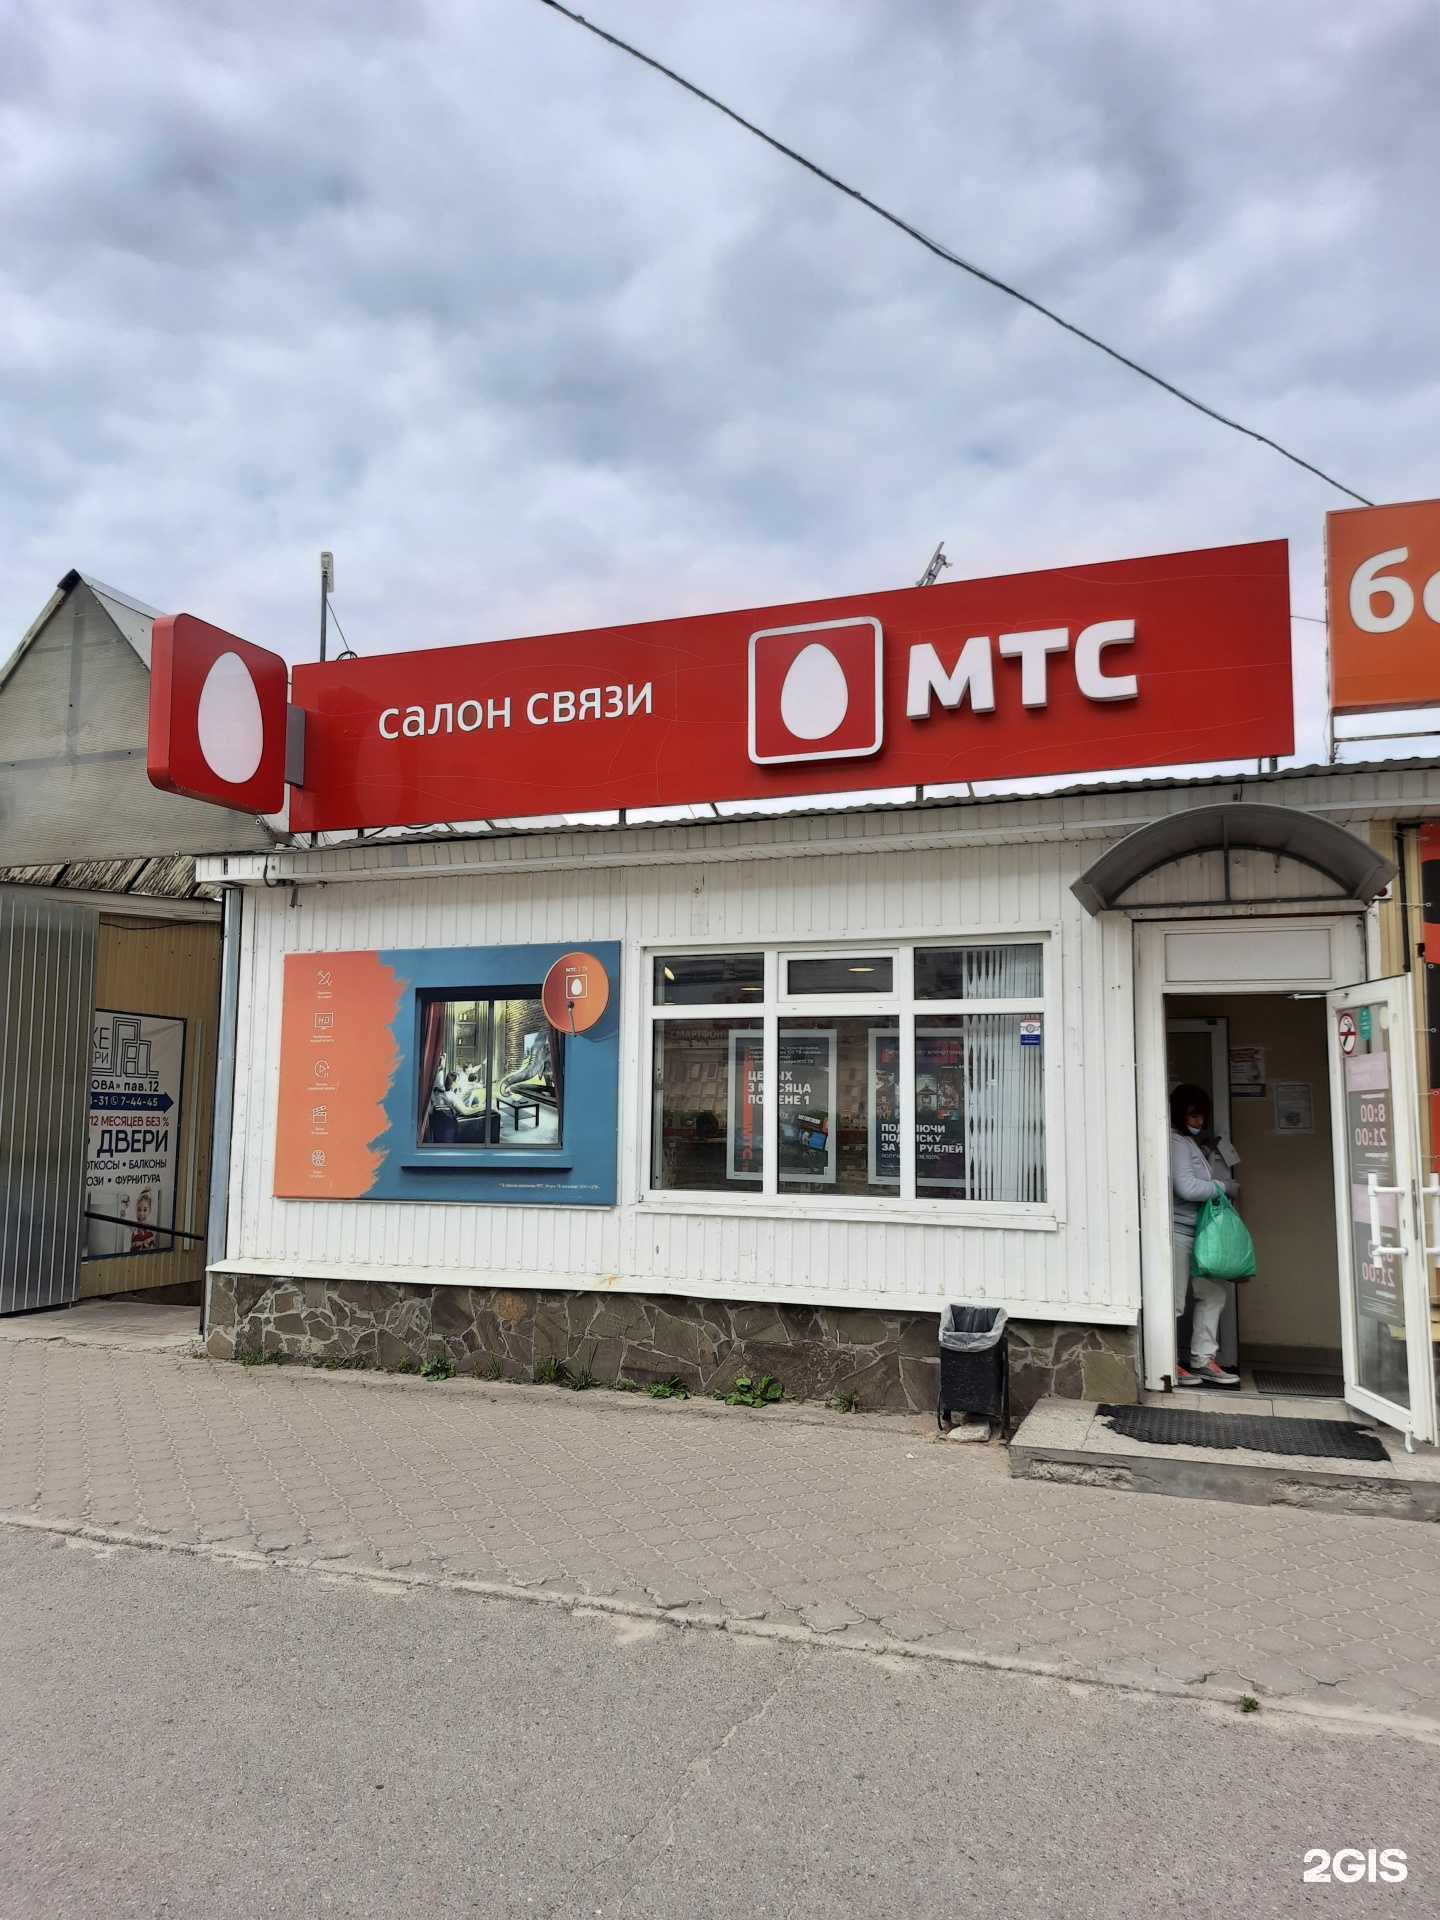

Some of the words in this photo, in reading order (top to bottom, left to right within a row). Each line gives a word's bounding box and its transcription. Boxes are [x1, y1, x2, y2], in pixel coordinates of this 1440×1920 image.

[906, 619, 1138, 720] МТС
[378, 697, 512, 740] салон
[526, 682, 653, 726] связи
[101, 1116, 144, 1128] МЕСЯЦЕВ
[145, 1116, 161, 1127] БЕЗ
[96, 1129, 169, 1158] ДВЕРИ
[919, 1142, 964, 1154] РУБЛЕЙ
[128, 1158, 167, 1170] БАЛКОНЫ
[115, 1173, 161, 1185] ФУРНИТУРА
